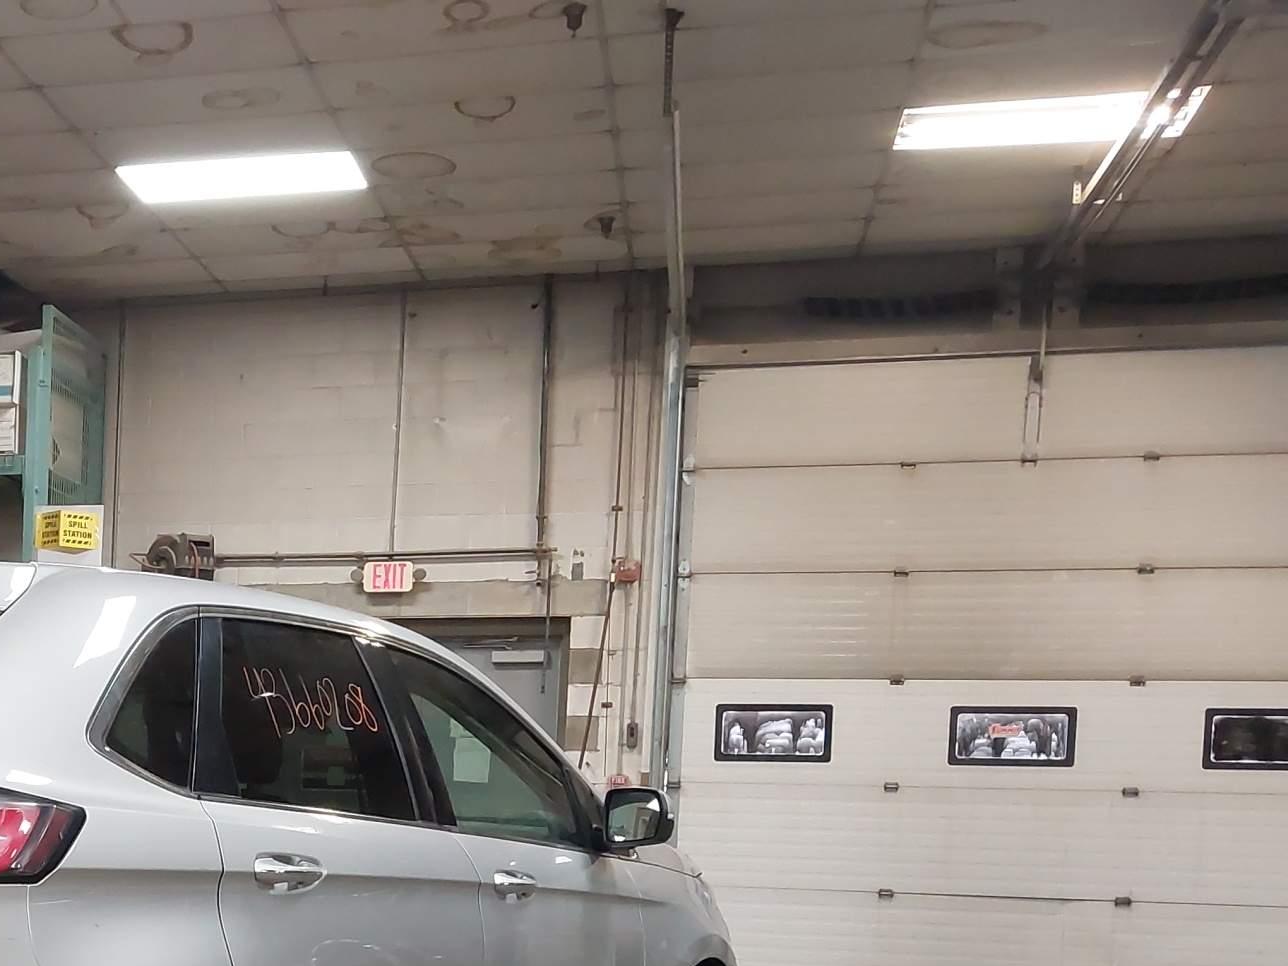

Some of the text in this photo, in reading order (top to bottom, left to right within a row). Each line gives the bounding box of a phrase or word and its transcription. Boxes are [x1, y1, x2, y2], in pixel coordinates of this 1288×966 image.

[68, 520, 88, 529] SPILL
[62, 529, 93, 539] STATION
[372, 563, 408, 589] EXIT
[243, 666, 378, 739] 43660208
